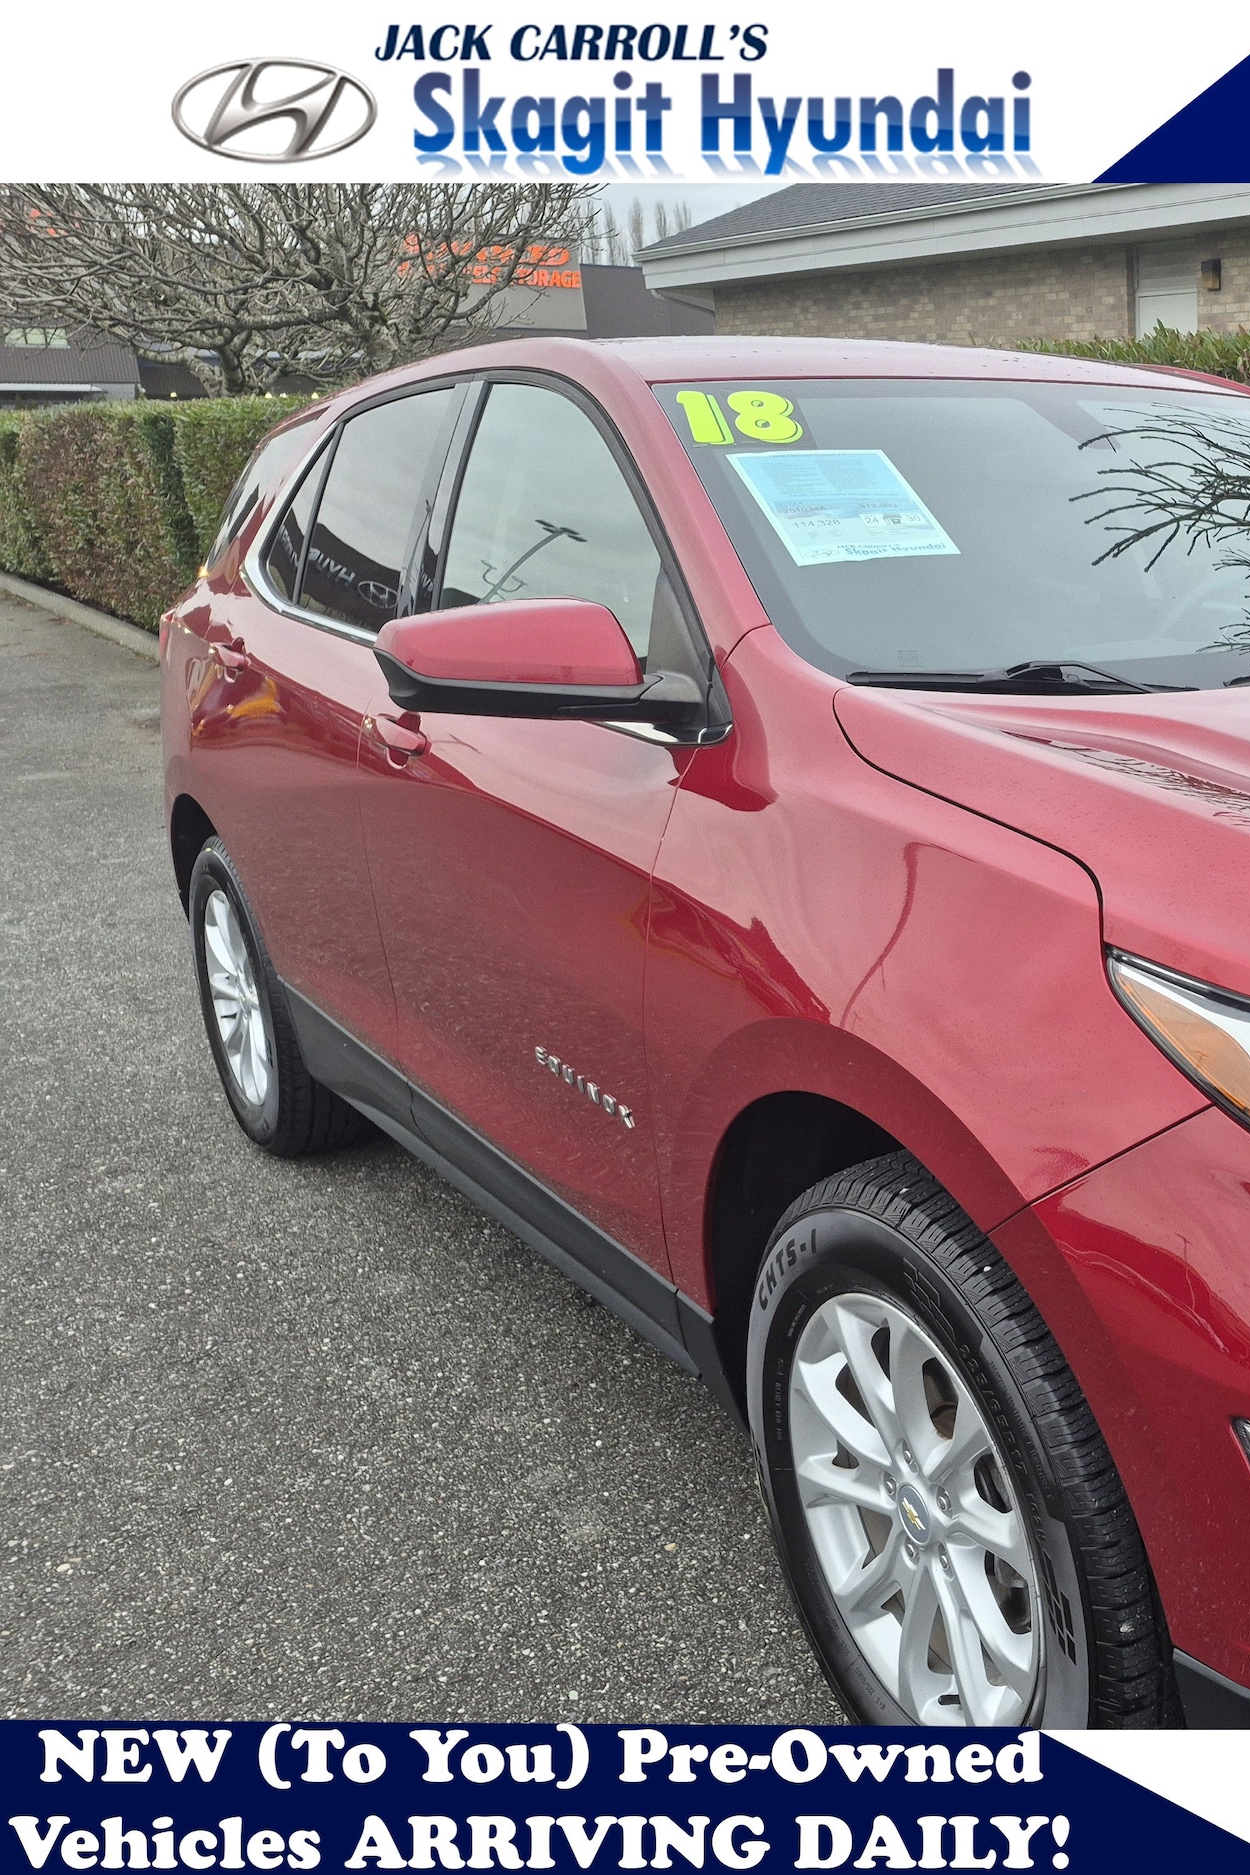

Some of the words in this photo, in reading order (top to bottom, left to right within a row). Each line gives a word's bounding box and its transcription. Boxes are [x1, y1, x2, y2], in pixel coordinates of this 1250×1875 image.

[676, 390, 804, 446] 18
[793, 518, 841, 529] 114,328
[864, 516, 880, 524] 24
[906, 515, 922, 523] 30
[534, 1045, 636, 1129] EQUINOX
